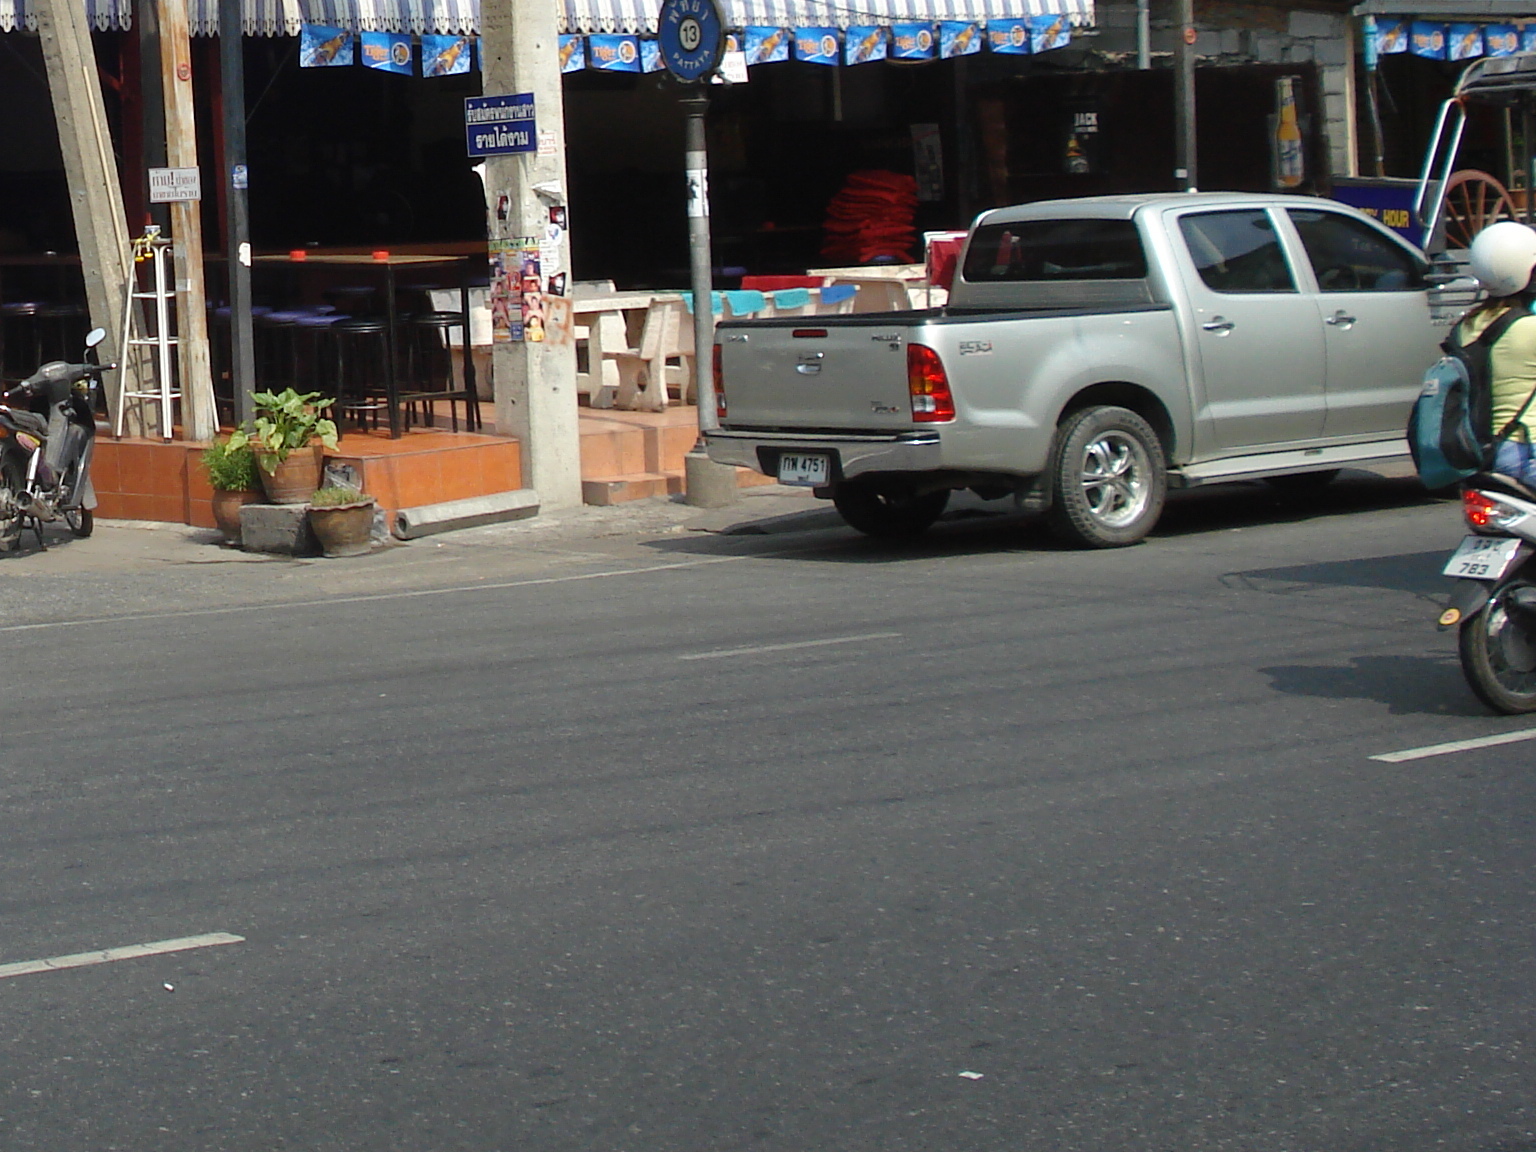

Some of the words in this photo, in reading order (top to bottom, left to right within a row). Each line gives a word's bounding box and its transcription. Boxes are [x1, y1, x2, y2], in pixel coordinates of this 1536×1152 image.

[683, 25, 698, 43] 13
[672, 49, 710, 70] PATTAYA
[1074, 112, 1098, 127] JACK
[475, 125, 529, 149] รายได้งาม
[1383, 209, 1410, 228] HOUR
[800, 456, 825, 474] 4751
[1458, 562, 1490, 576] 783
